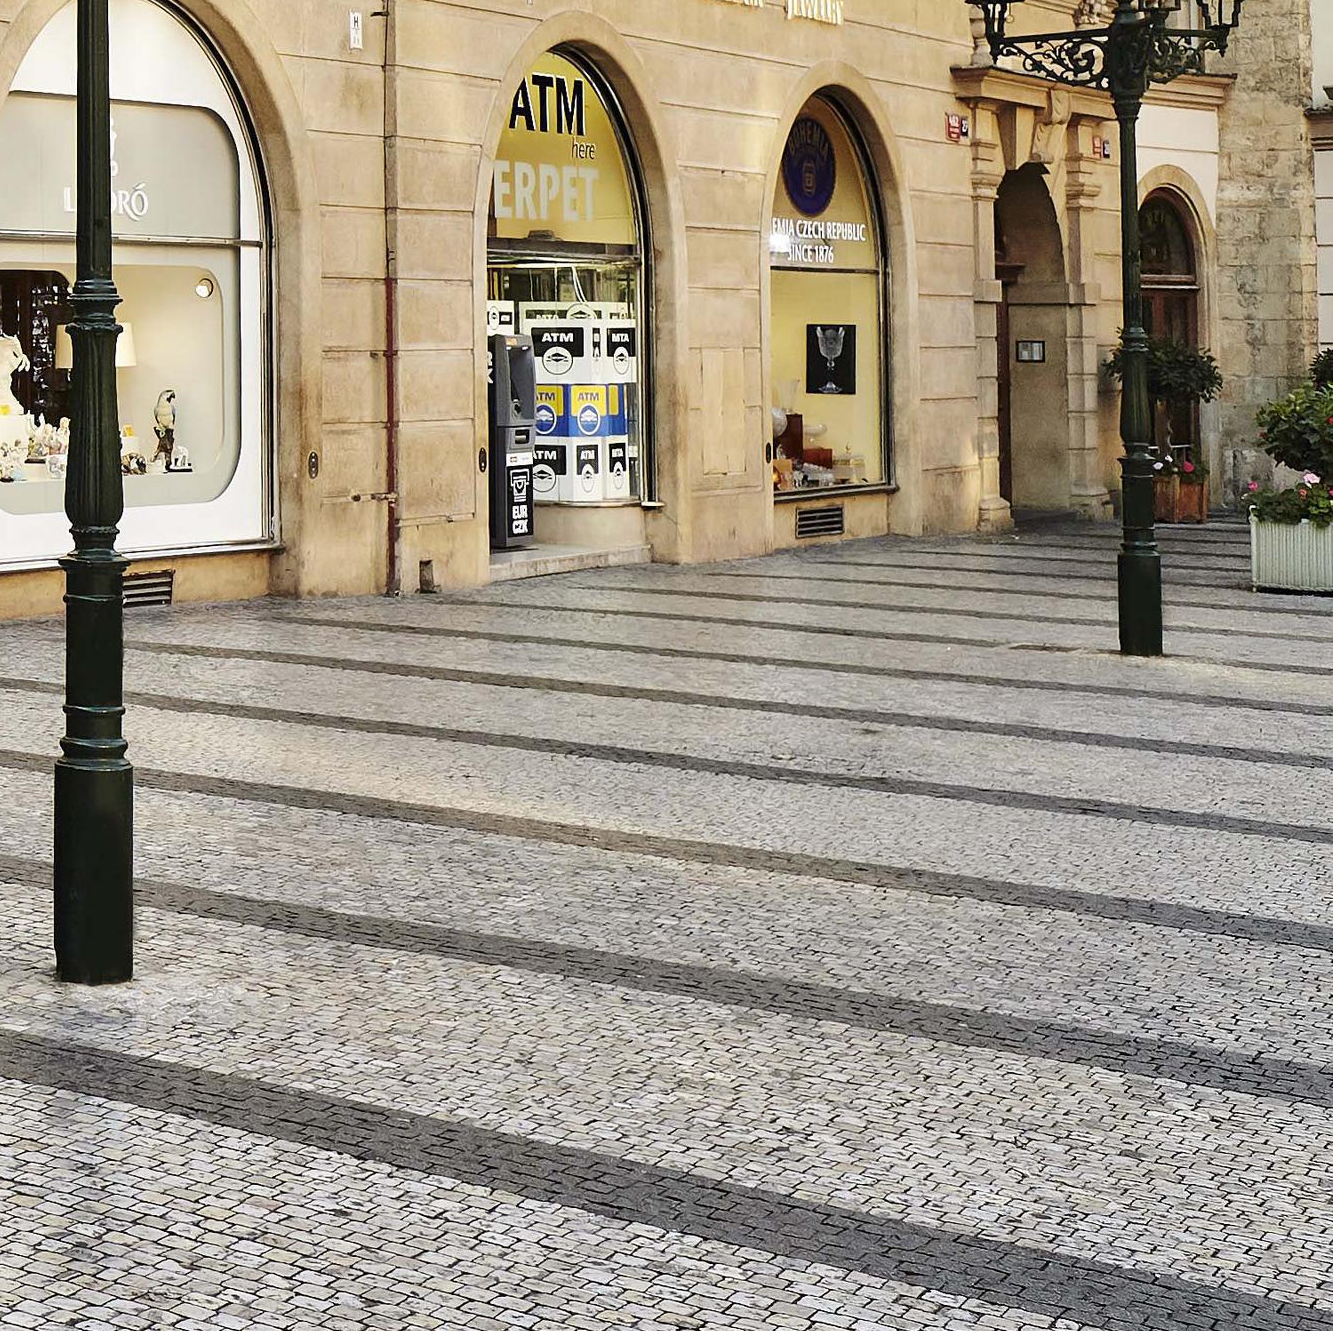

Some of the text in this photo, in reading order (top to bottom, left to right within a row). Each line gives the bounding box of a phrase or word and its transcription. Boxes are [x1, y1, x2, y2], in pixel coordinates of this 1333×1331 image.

[508, 72, 586, 136] ATM
[571, 138, 597, 159] here
[494, 160, 600, 223] ERPET
[796, 220, 825, 239] CZECH
[826, 221, 866, 241] REPUBLIC
[787, 244, 835, 263] SINCE 1876
[541, 332, 574, 343] ATM
[577, 391, 600, 402] ATM
